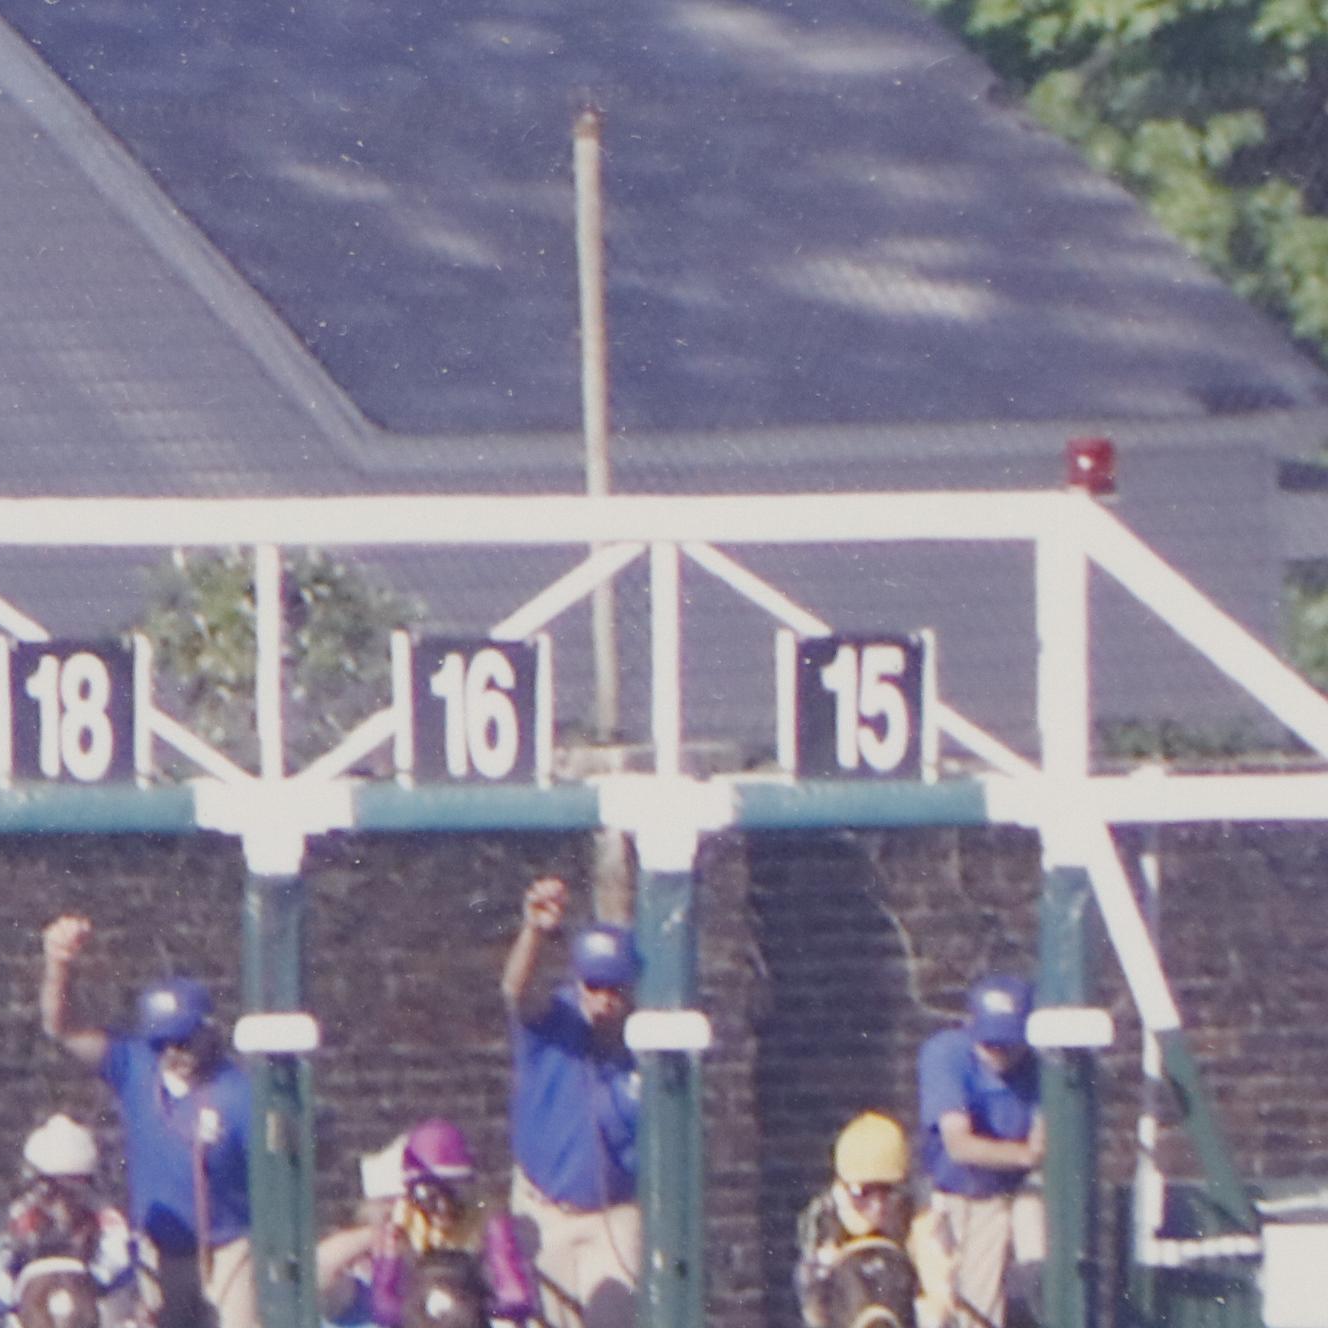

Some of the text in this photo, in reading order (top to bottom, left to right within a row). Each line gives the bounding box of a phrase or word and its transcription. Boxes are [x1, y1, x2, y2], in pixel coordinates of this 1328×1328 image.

[26, 653, 113, 781] 18
[430, 648, 519, 779] 16
[821, 645, 909, 771] 15
